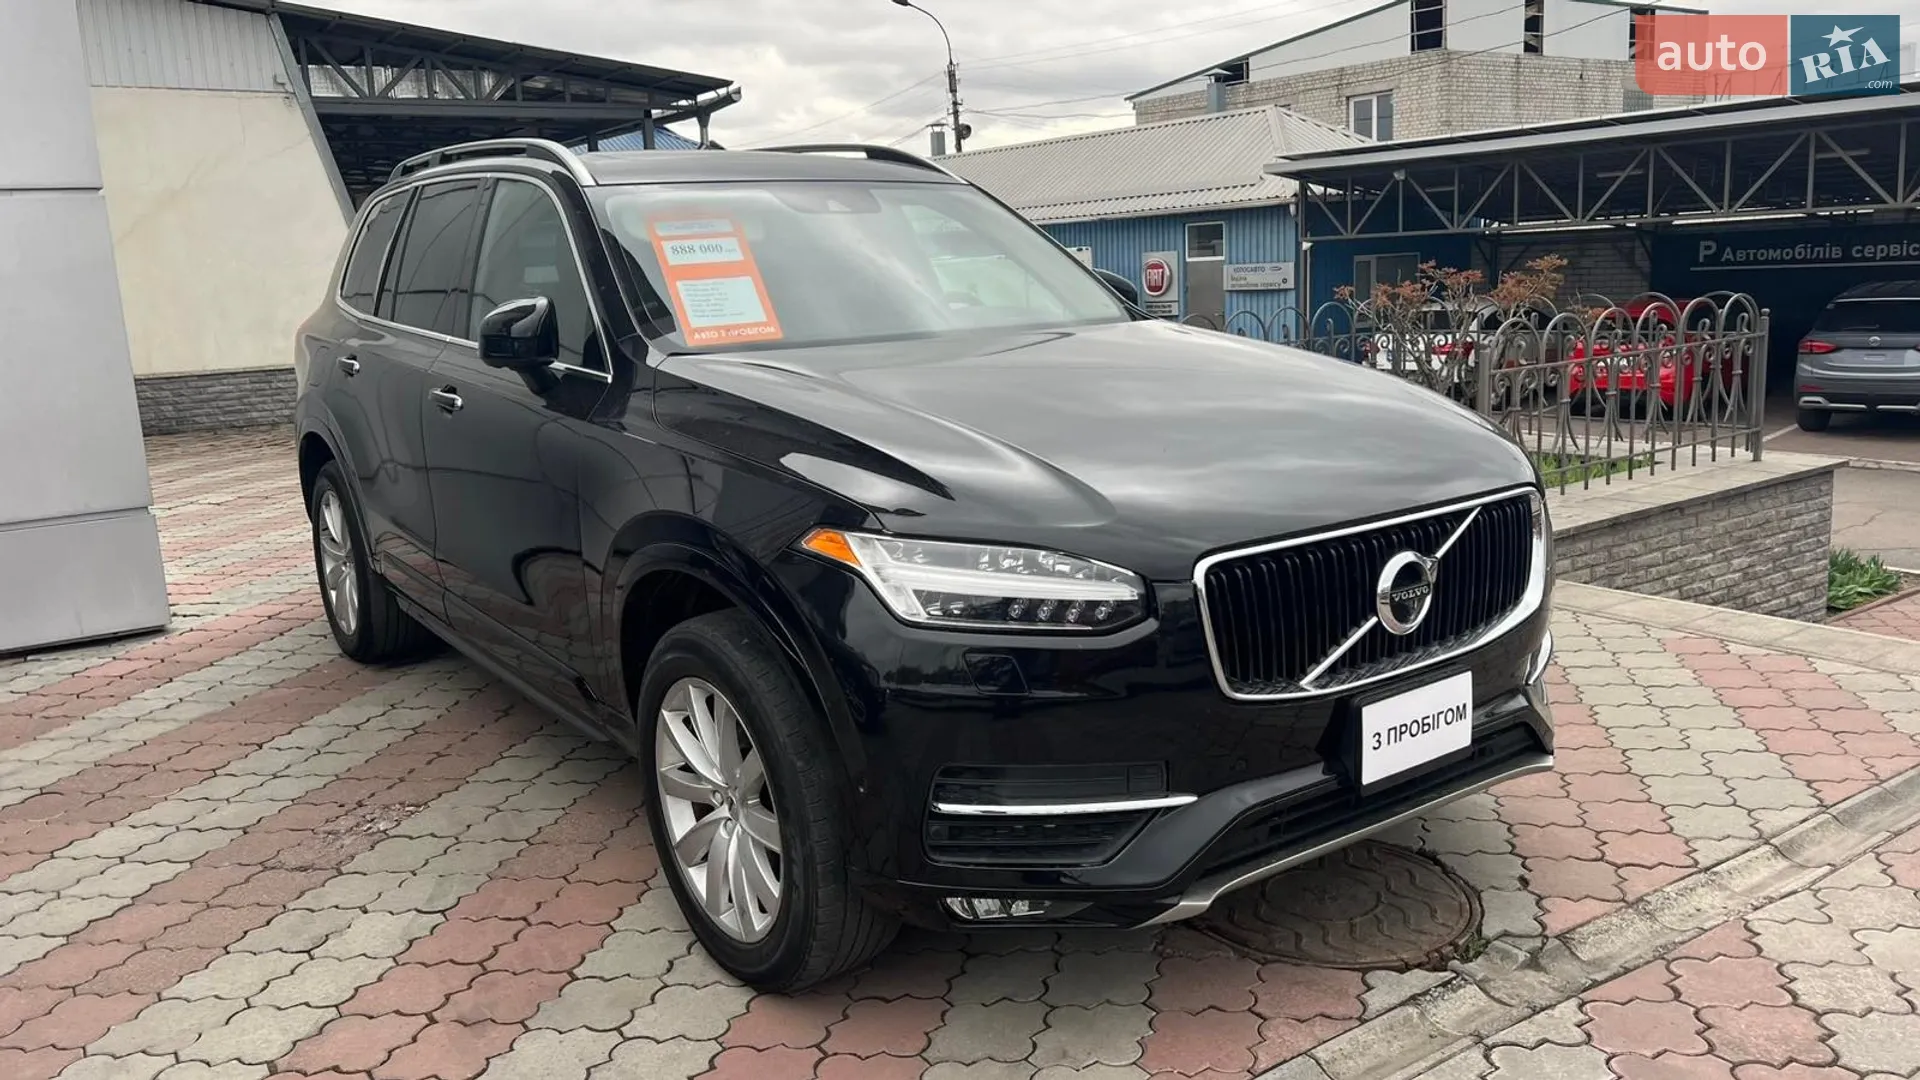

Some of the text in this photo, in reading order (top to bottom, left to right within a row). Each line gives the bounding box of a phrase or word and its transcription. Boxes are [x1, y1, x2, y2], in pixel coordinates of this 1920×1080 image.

[670, 243, 696, 255] 888
[699, 243, 723, 255] 000
[1720, 243, 1843, 262] Автомобілів
[1852, 240, 1920, 260] сервіс
[1146, 269, 1163, 286] FIAT
[1391, 585, 1429, 602] VOLVO
[1387, 702, 1467, 746] ПРОБІГОМ
